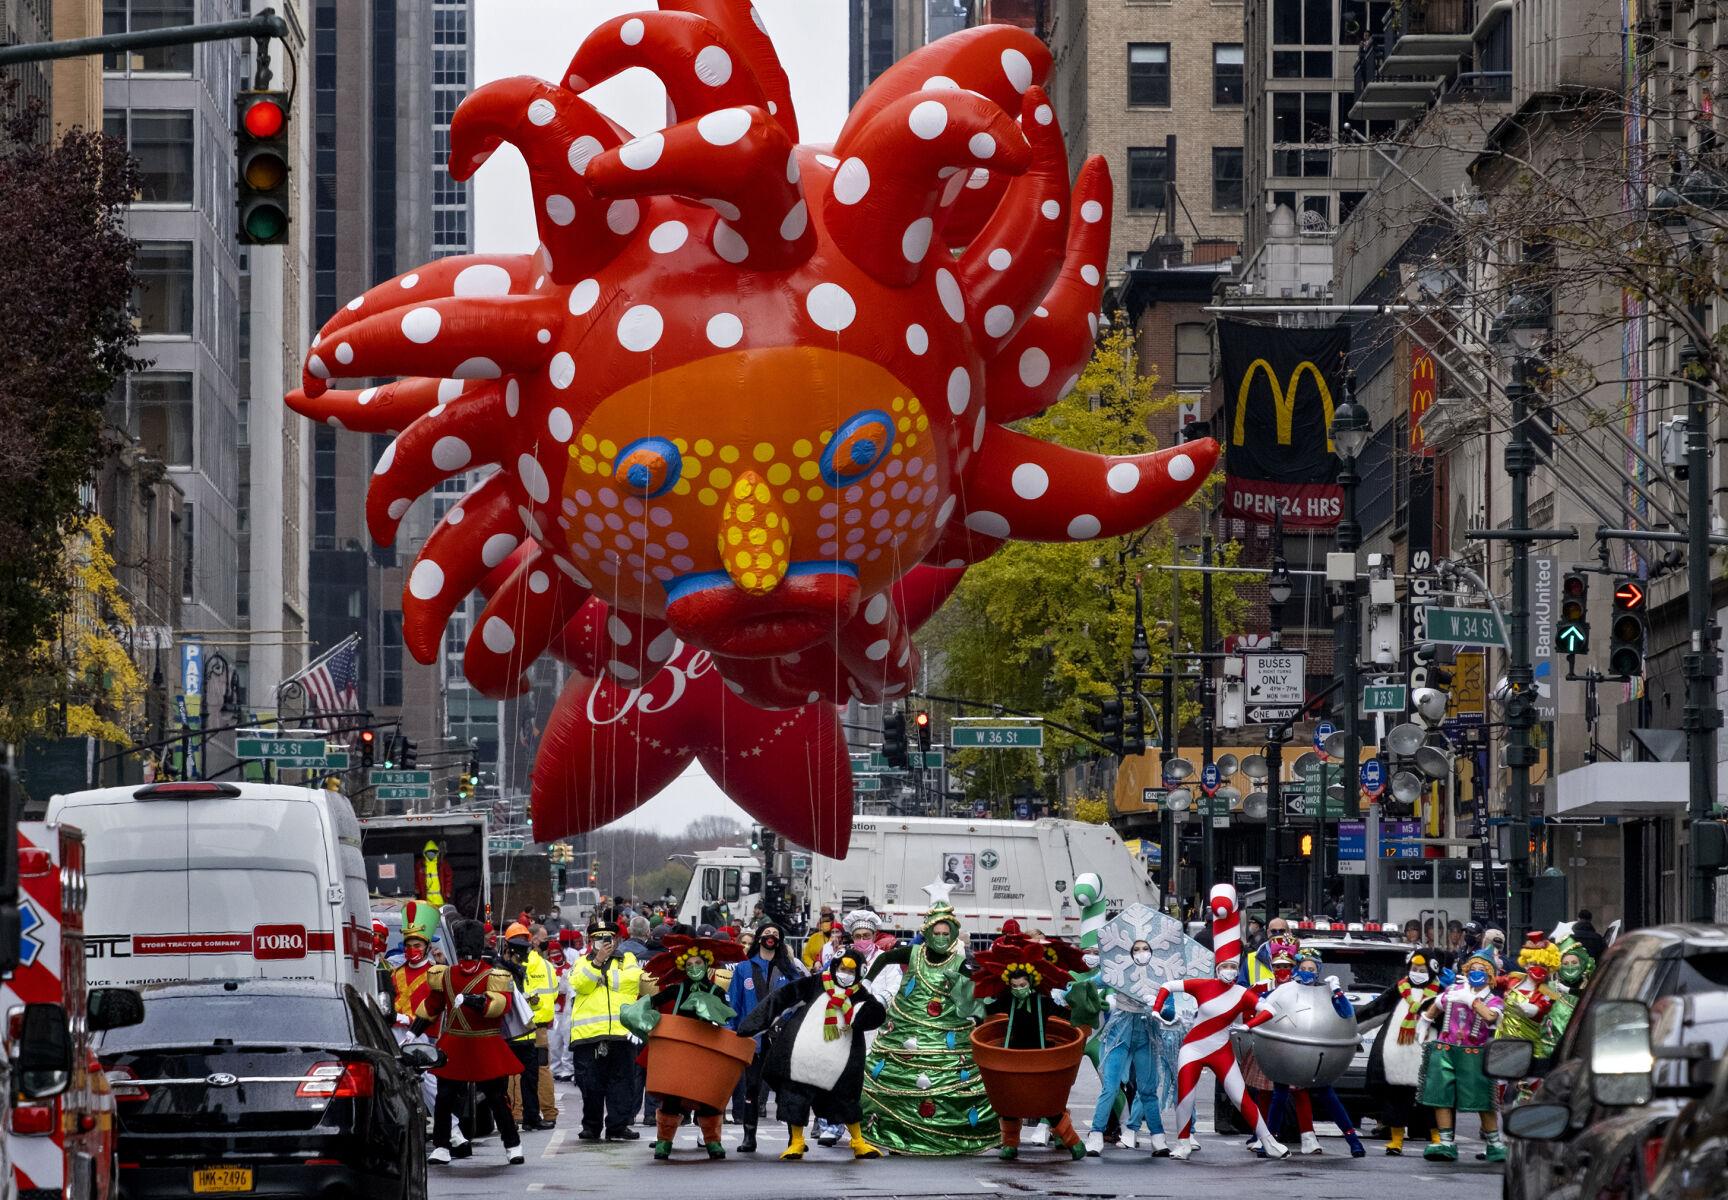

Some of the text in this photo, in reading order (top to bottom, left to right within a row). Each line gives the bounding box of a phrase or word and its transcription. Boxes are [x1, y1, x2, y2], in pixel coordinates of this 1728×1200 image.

[1233, 490, 1341, 517] OPEN 24 HRS
[1535, 559, 1551, 658] BankUnited
[1450, 616, 1494, 639] W 34 St
[1258, 659, 1291, 668] BUSES
[1261, 675, 1288, 685] ONLY
[1253, 709, 1295, 719] ONE WAY
[1538, 707, 1555, 717] TM
[976, 732, 1018, 743] W 36 St
[260, 742, 302, 755] W 36 St
[1402, 824, 1413, 833] M5
[1385, 848, 1397, 857] 17
[1401, 848, 1419, 857] M55
[992, 884, 1011, 892] SERVICE
[256, 934, 302, 950] TORO
